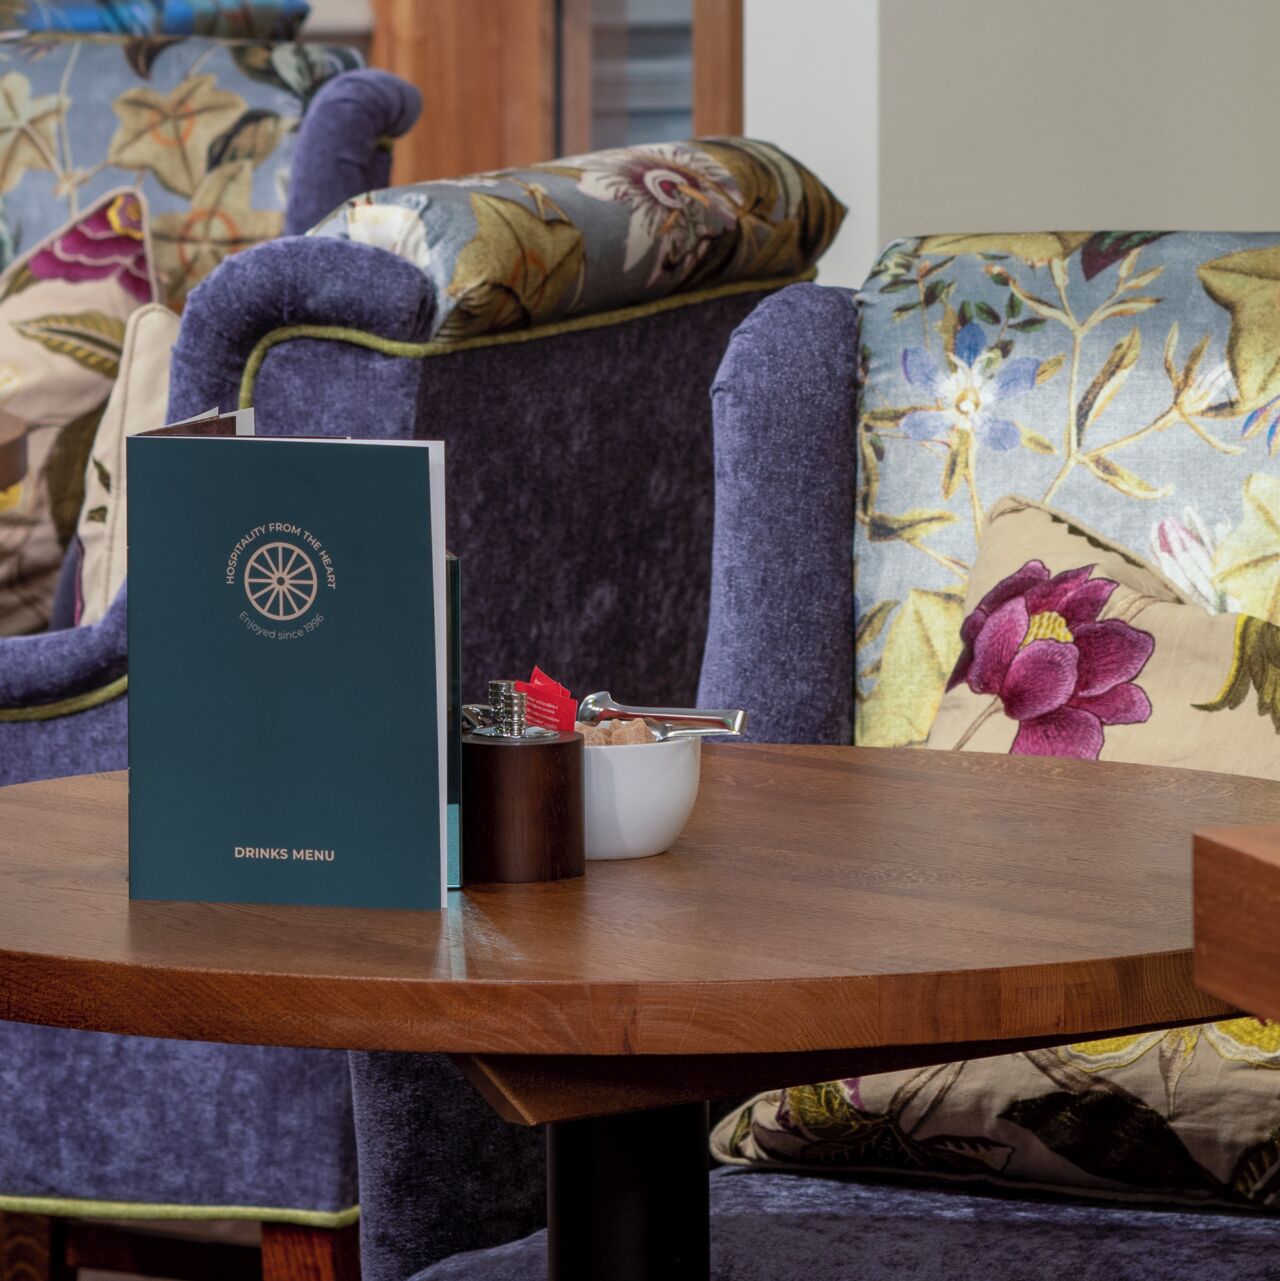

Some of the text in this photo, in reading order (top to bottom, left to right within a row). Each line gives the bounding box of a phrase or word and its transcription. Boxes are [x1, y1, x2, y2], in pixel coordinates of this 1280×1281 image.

[226, 522, 336, 590] HOSPITALITY FROM THE HEART
[239, 611, 325, 640] Enjoyed since 1996
[234, 846, 335, 861] DRINKS MENU
